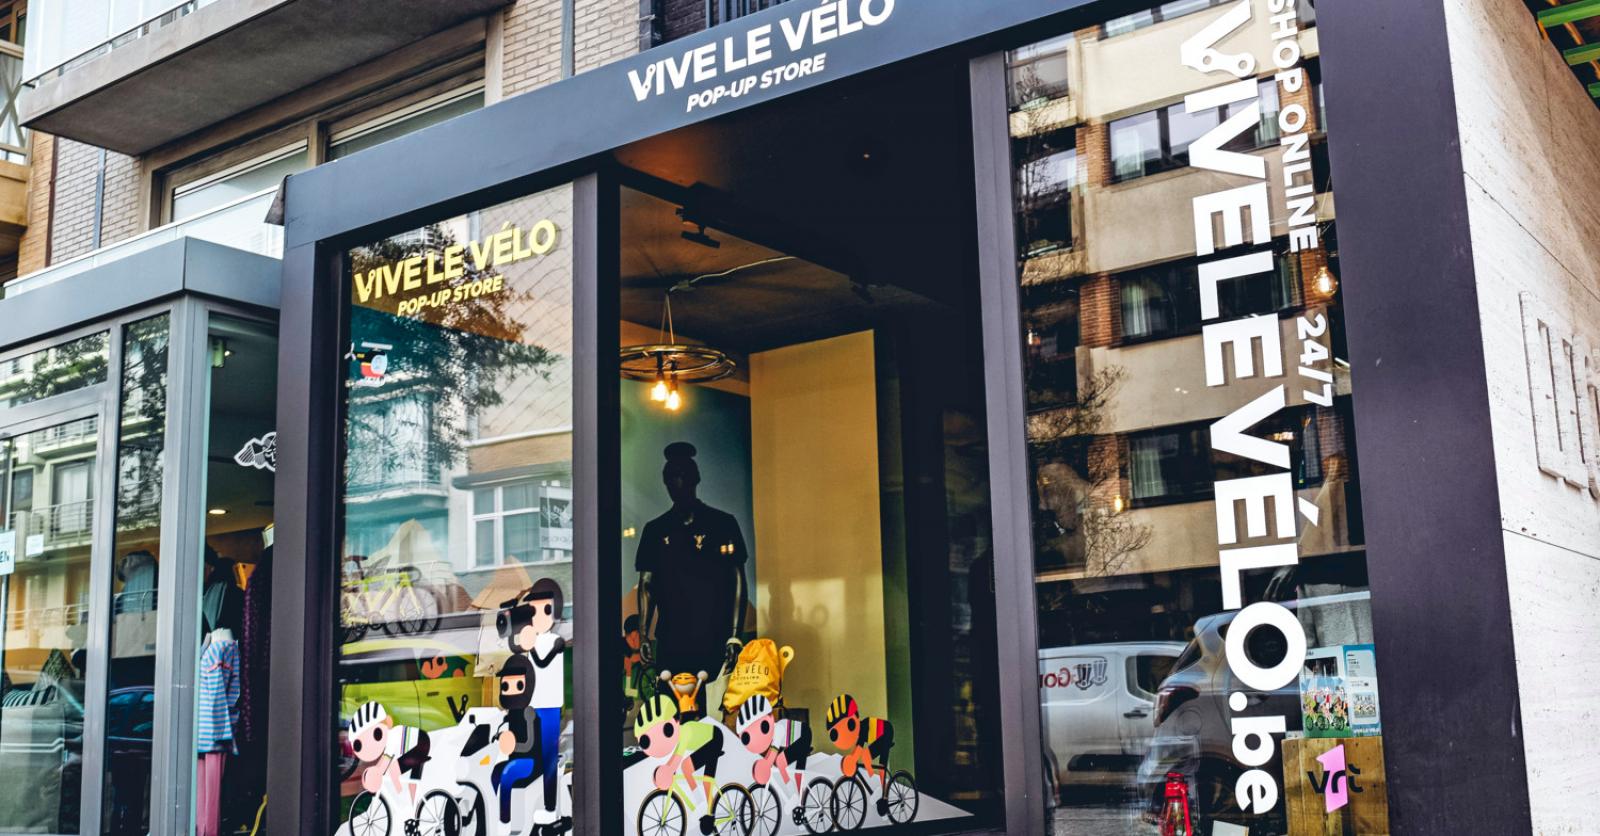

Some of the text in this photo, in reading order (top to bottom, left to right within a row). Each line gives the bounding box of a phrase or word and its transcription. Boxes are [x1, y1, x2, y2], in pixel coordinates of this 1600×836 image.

[627, 0, 895, 102] VIVE LE VÉLO
[686, 52, 826, 112] POP-UP STORE
[1278, 102, 1318, 253] ONLINE
[354, 218, 556, 303] VIVE LE VÉLO
[397, 273, 504, 317] POP-UP STORE
[1297, 313, 1333, 407] 24/7
[1180, 0, 1319, 815] VIVELEVÉLO.be
[1307, 763, 1363, 793] vrt
